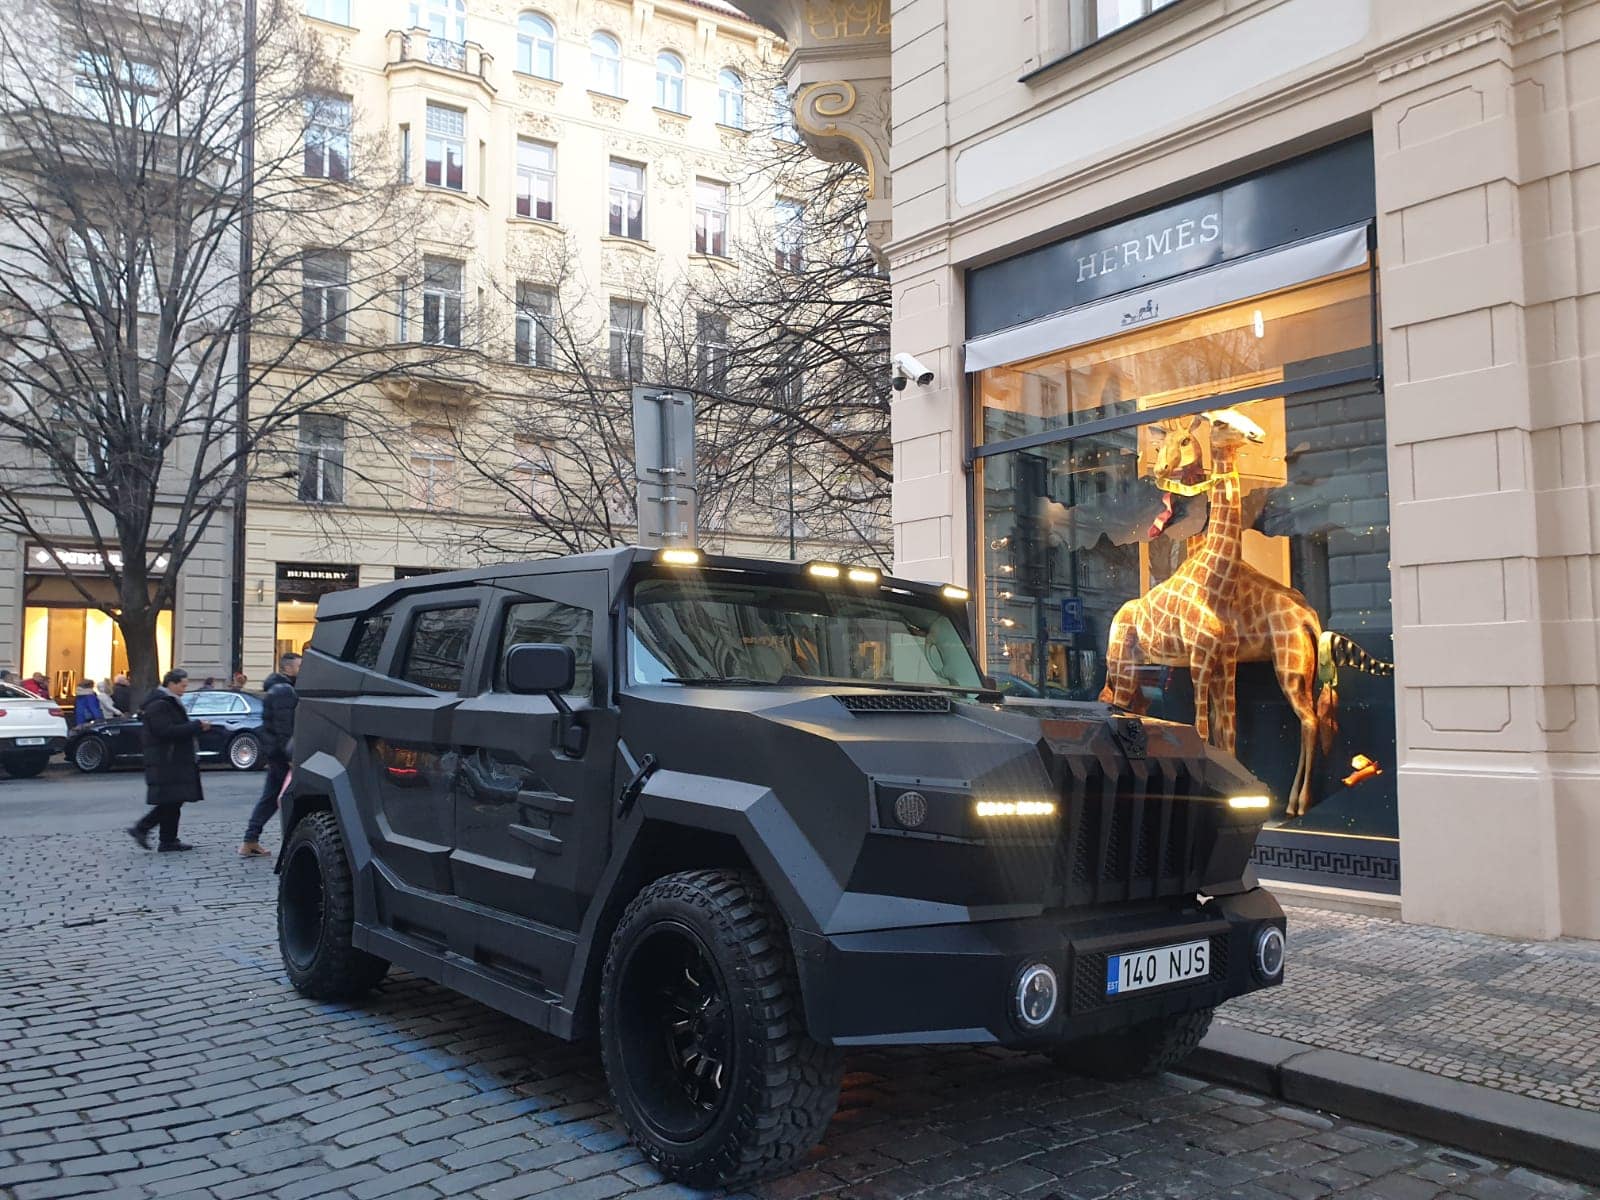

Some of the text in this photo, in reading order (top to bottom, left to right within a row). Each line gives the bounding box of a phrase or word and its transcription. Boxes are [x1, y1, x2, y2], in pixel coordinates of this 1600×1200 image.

[287, 570, 348, 579] BURBERRY
[1124, 946, 1205, 987] 140 NJS
[1107, 981, 1119, 991] EST
